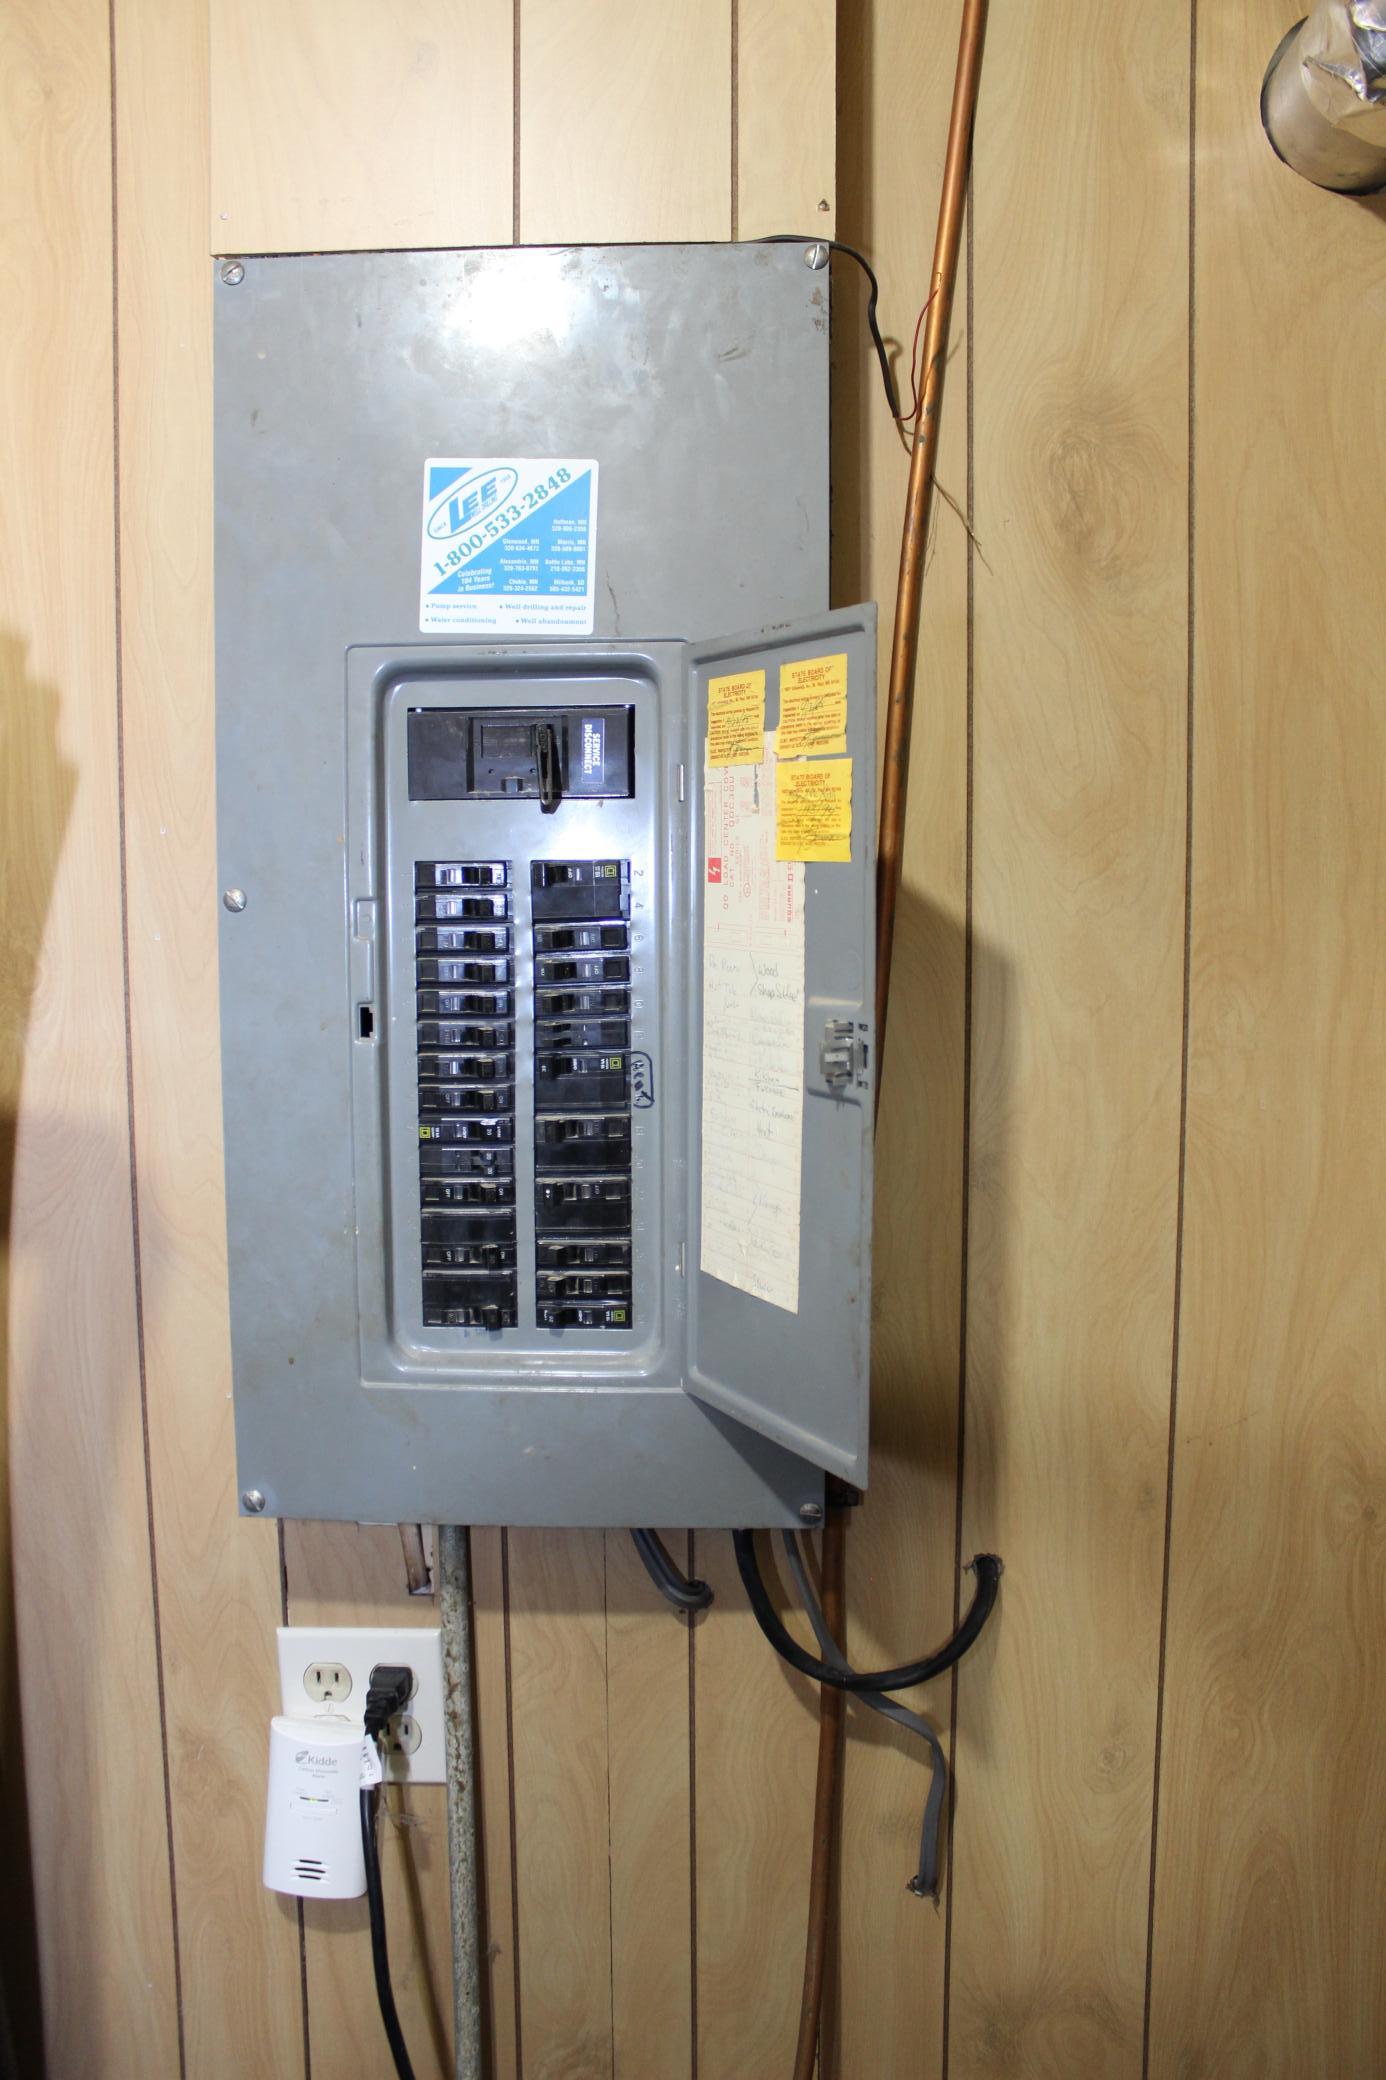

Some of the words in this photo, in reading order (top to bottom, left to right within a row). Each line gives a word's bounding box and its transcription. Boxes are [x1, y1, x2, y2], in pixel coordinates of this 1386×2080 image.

[449, 477, 497, 533] LEE
[434, 468, 571, 576] 1-800-533-2848
[431, 603, 450, 611] Pump
[522, 603, 549, 611] drilling
[584, 723, 593, 775] DISCONNECT
[633, 868, 644, 877] 2
[308, 1755, 338, 1766] Kidde
